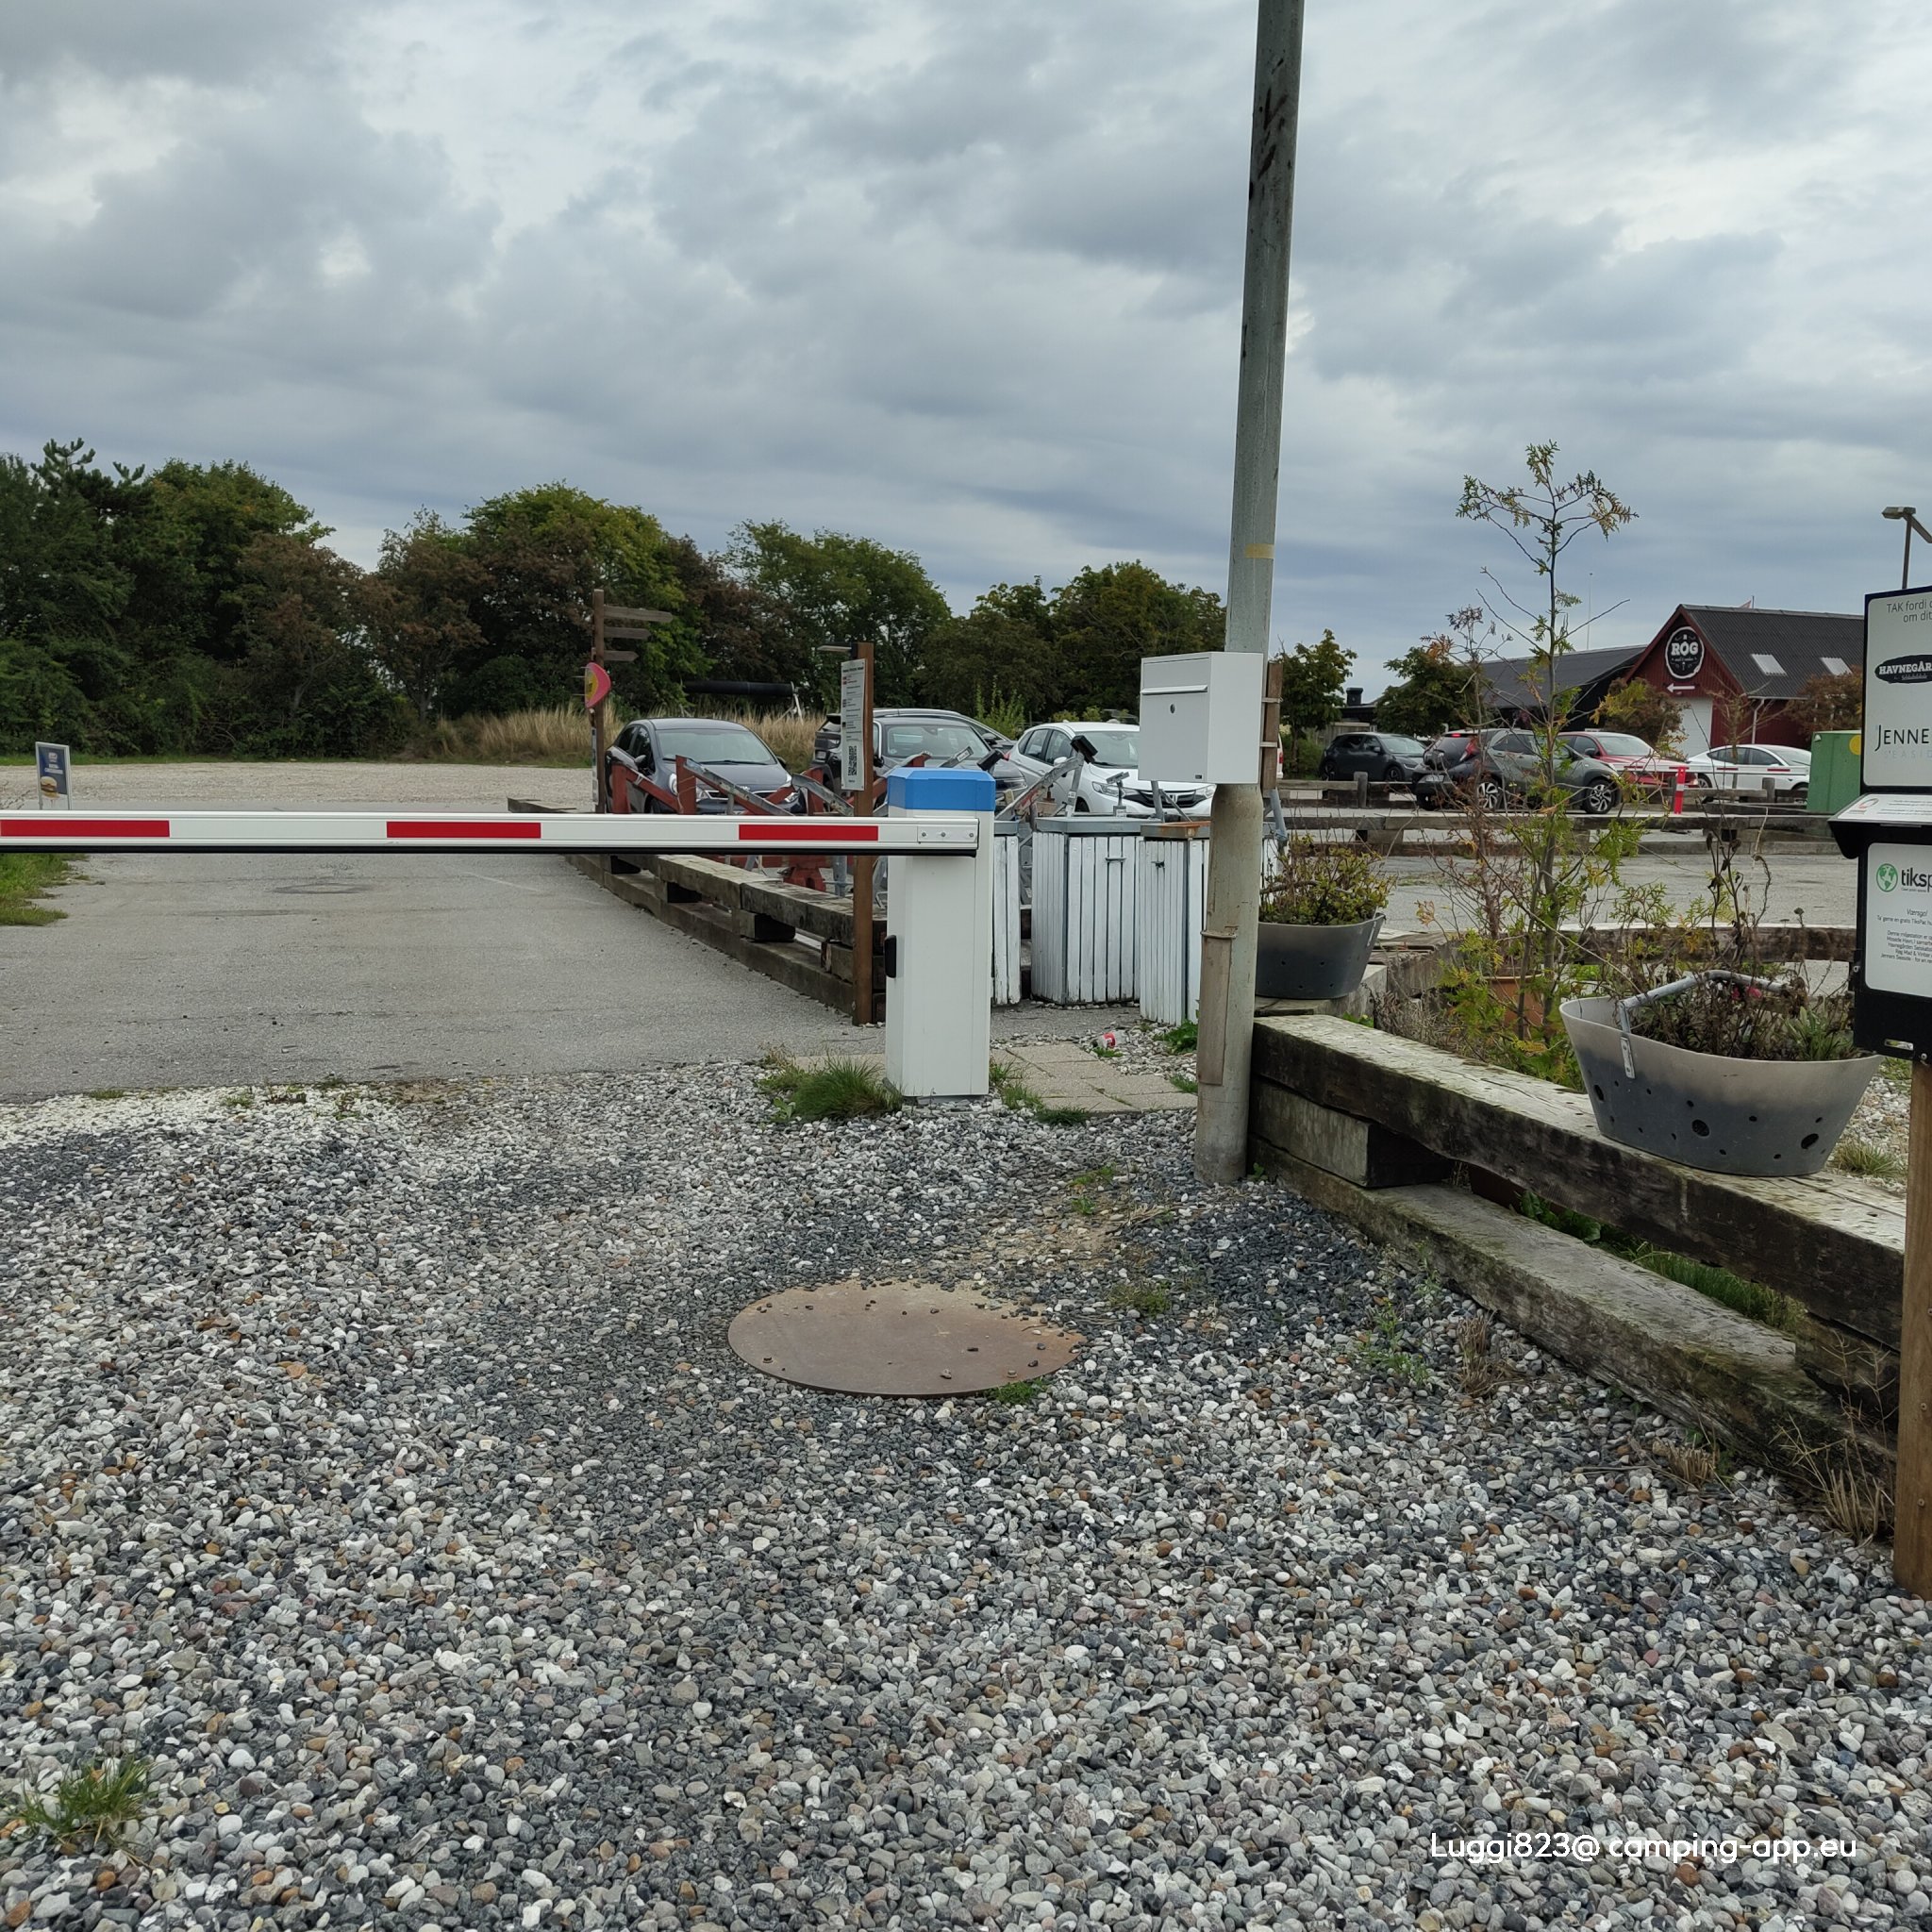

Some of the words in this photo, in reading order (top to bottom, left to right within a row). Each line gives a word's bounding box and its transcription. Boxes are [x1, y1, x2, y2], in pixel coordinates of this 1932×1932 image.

[1887, 602, 1904, 613] TAK
[1906, 599, 1927, 611] fordi
[1904, 614, 1918, 623] om
